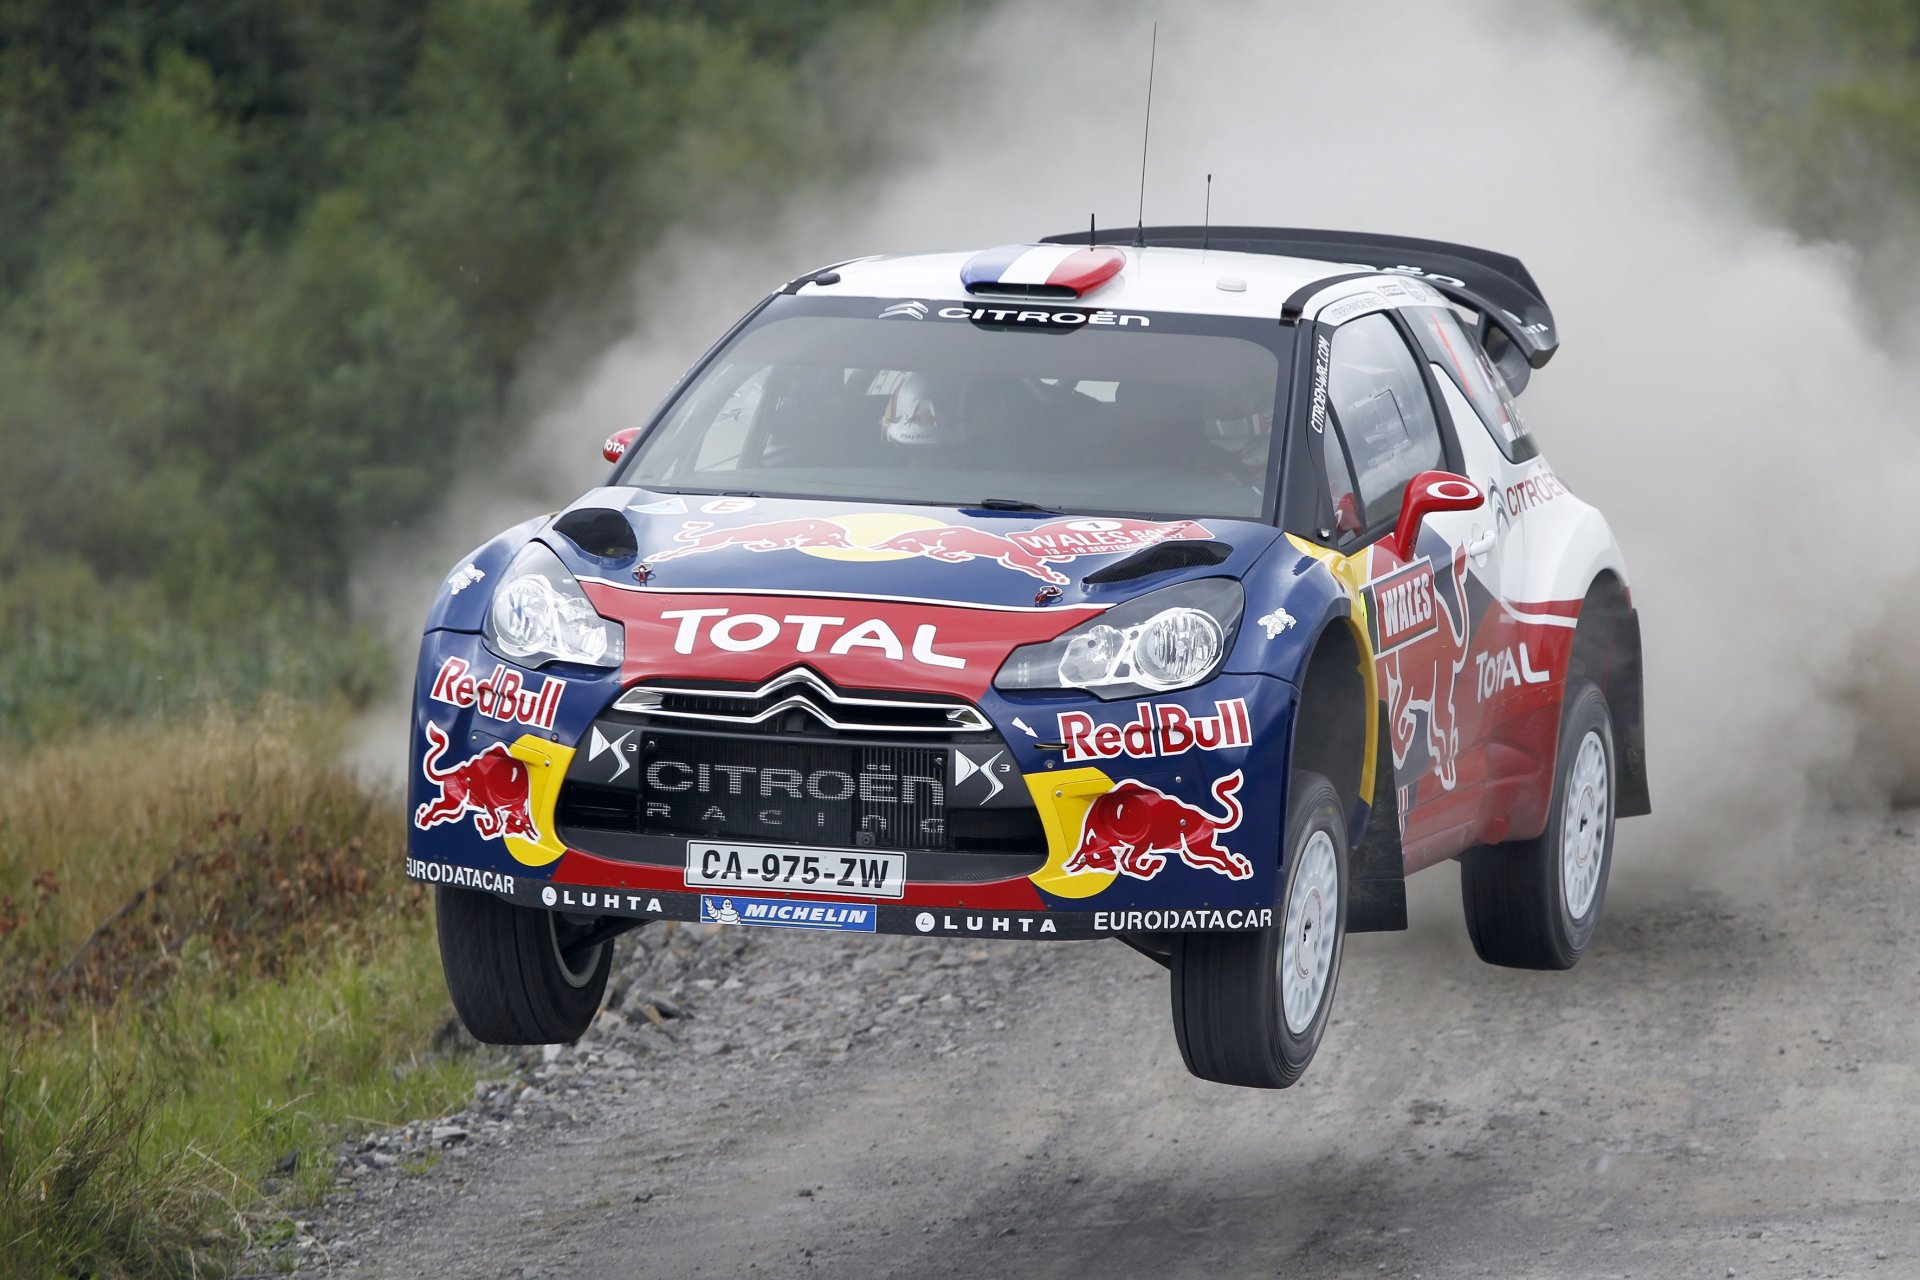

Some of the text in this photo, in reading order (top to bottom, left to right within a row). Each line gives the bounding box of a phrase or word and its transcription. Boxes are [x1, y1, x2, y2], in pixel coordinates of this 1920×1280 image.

[1311, 334, 1330, 433] CITROEN-WRC.COM
[603, 439, 625, 453] TOTA
[1086, 521, 1102, 530] 1
[1019, 530, 1133, 549] WALES
[1381, 572, 1433, 638] WALES
[660, 607, 967, 670] TOTAL
[1475, 642, 1550, 703] TOTAL
[702, 849, 889, 889] CA-975-ZW
[563, 890, 663, 913] LUHTA
[744, 903, 869, 925] MICHELIN
[944, 915, 1057, 933] LUHTA
[1094, 909, 1273, 931] EURODATACAR
